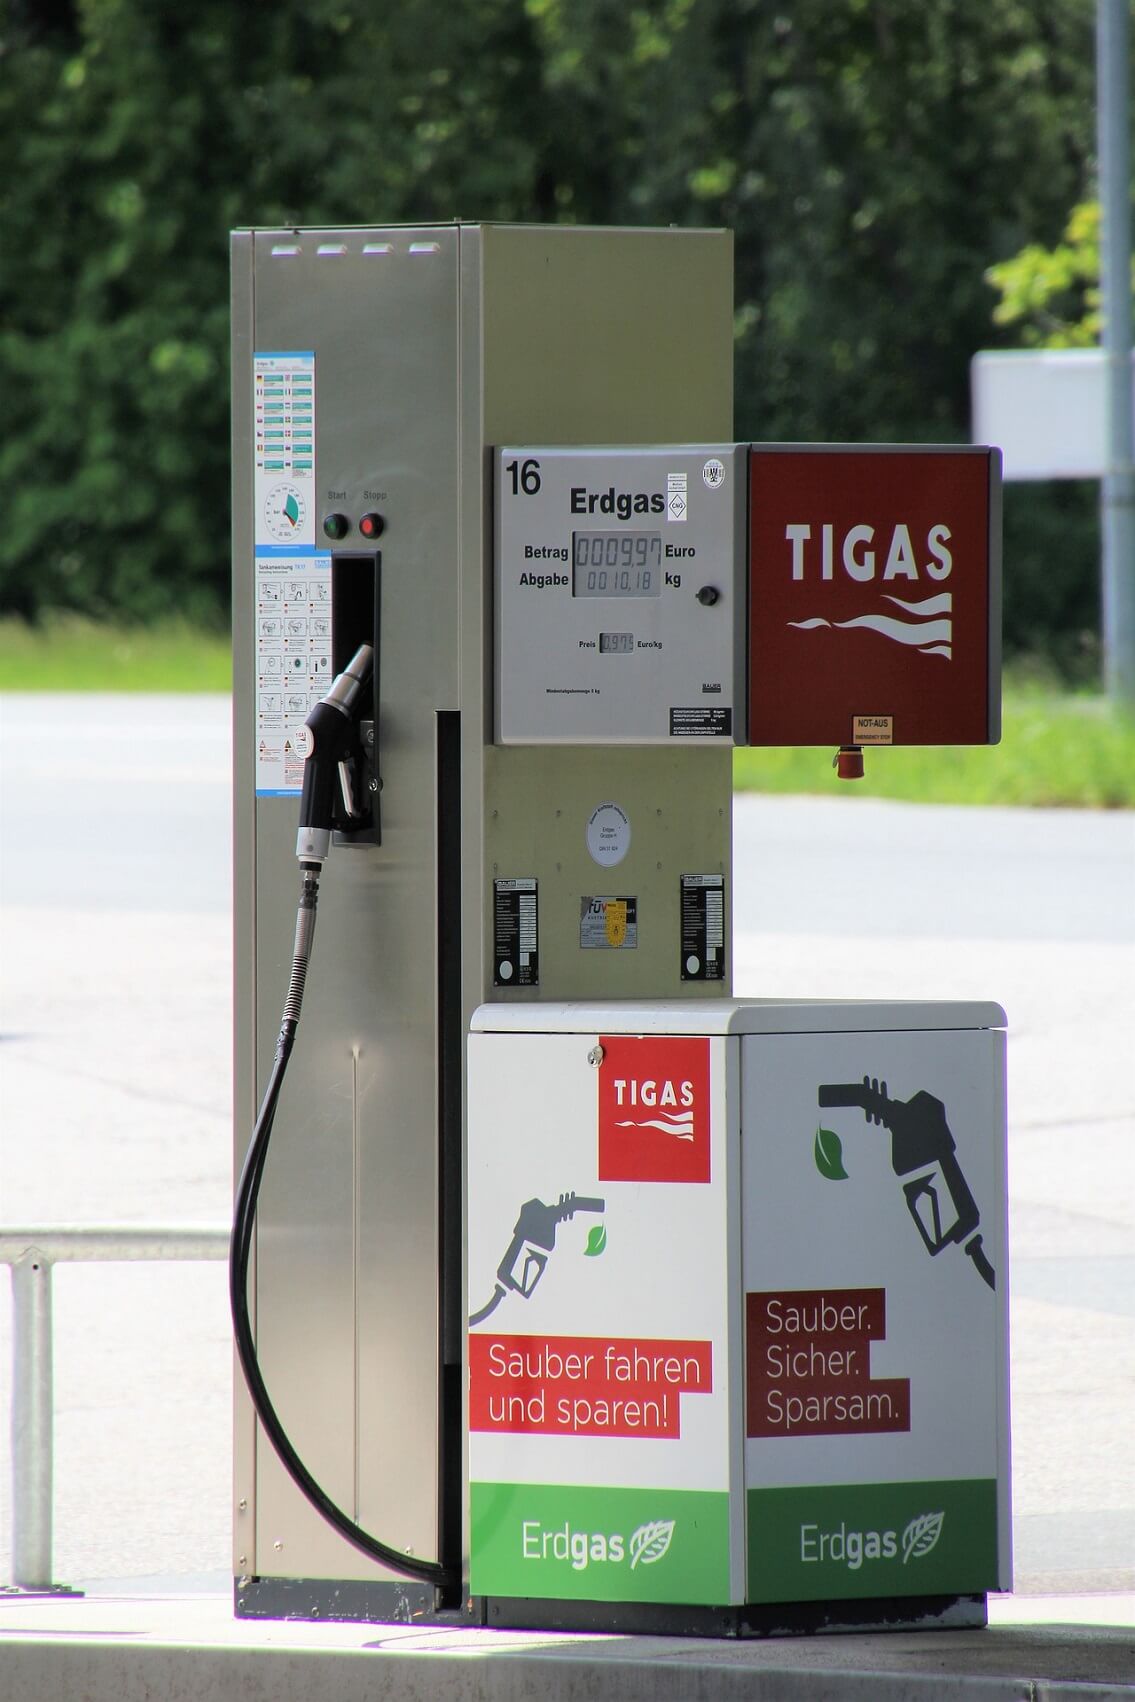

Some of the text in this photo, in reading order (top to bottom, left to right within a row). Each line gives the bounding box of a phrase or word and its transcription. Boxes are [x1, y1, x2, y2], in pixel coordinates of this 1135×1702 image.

[507, 459, 540, 495] 16
[328, 491, 346, 500] Start
[363, 490, 388, 501] Stopp
[571, 488, 665, 521] Erdgas
[524, 545, 569, 562] Betrag
[665, 545, 696, 558] Euro
[785, 524, 953, 582] TIGAS
[519, 573, 569, 588] Abgabe
[665, 572, 681, 588] kg
[637, 641, 663, 650] Euro/kg
[858, 719, 889, 728] NOT-AUS
[588, 899, 607, 914] TÜV
[614, 1080, 694, 1107] TIGAS
[766, 1297, 871, 1334] Sauber.
[488, 1343, 701, 1384] Sauber fahren
[766, 1342, 860, 1378] Sicher.
[488, 1389, 669, 1431] und sparen!
[766, 1389, 900, 1429] Sparsam.
[522, 1521, 625, 1571] Erdgas
[800, 1521, 898, 1570] Erdgas
